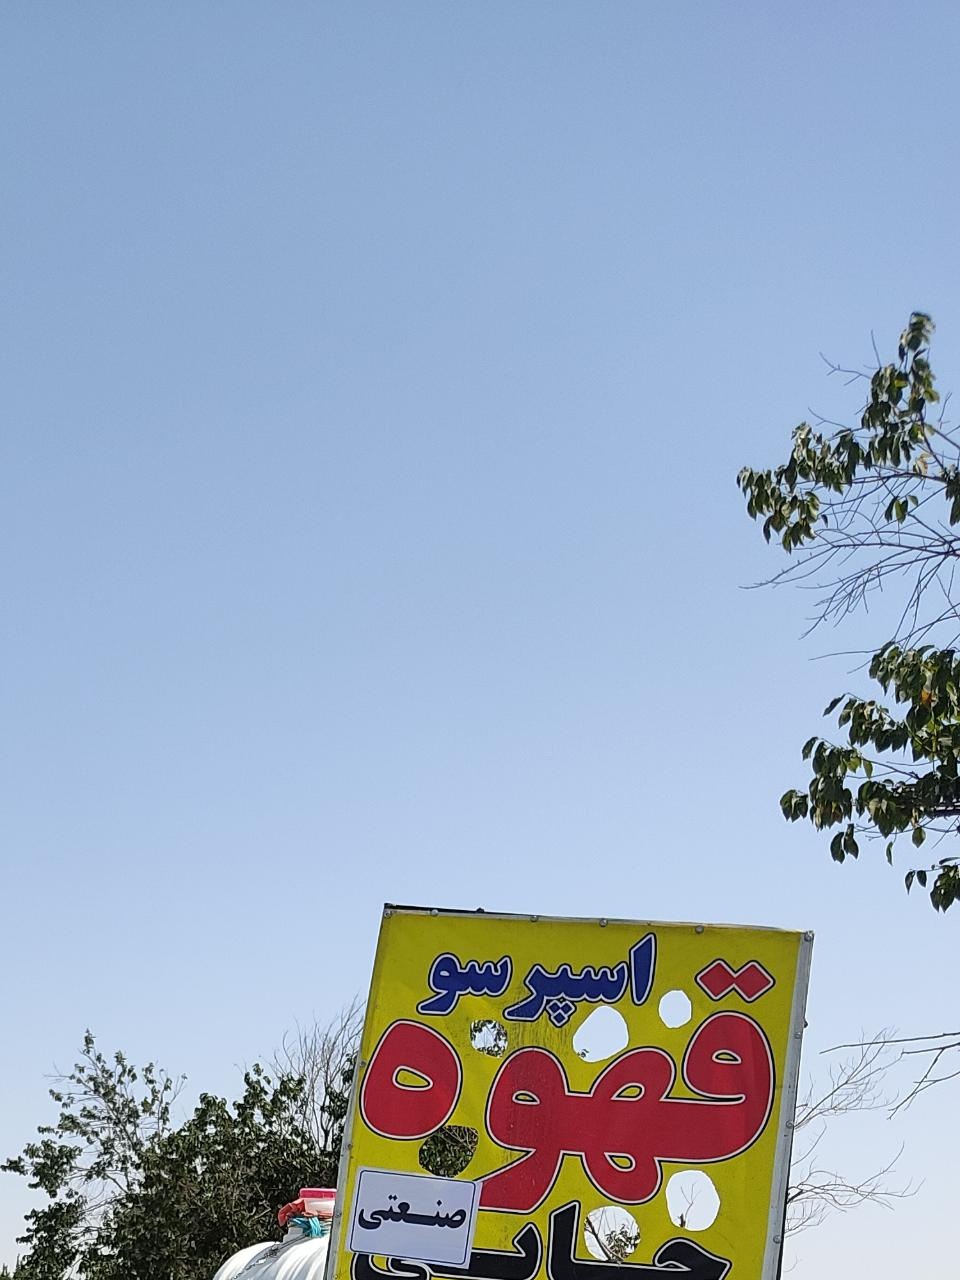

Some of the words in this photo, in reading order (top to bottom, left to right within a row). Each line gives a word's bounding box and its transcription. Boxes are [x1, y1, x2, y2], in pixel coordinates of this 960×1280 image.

[417, 933, 657, 1026] اسپرسو
[360, 959, 775, 1213] قهوه
[358, 1194, 467, 1231] صنعتی
